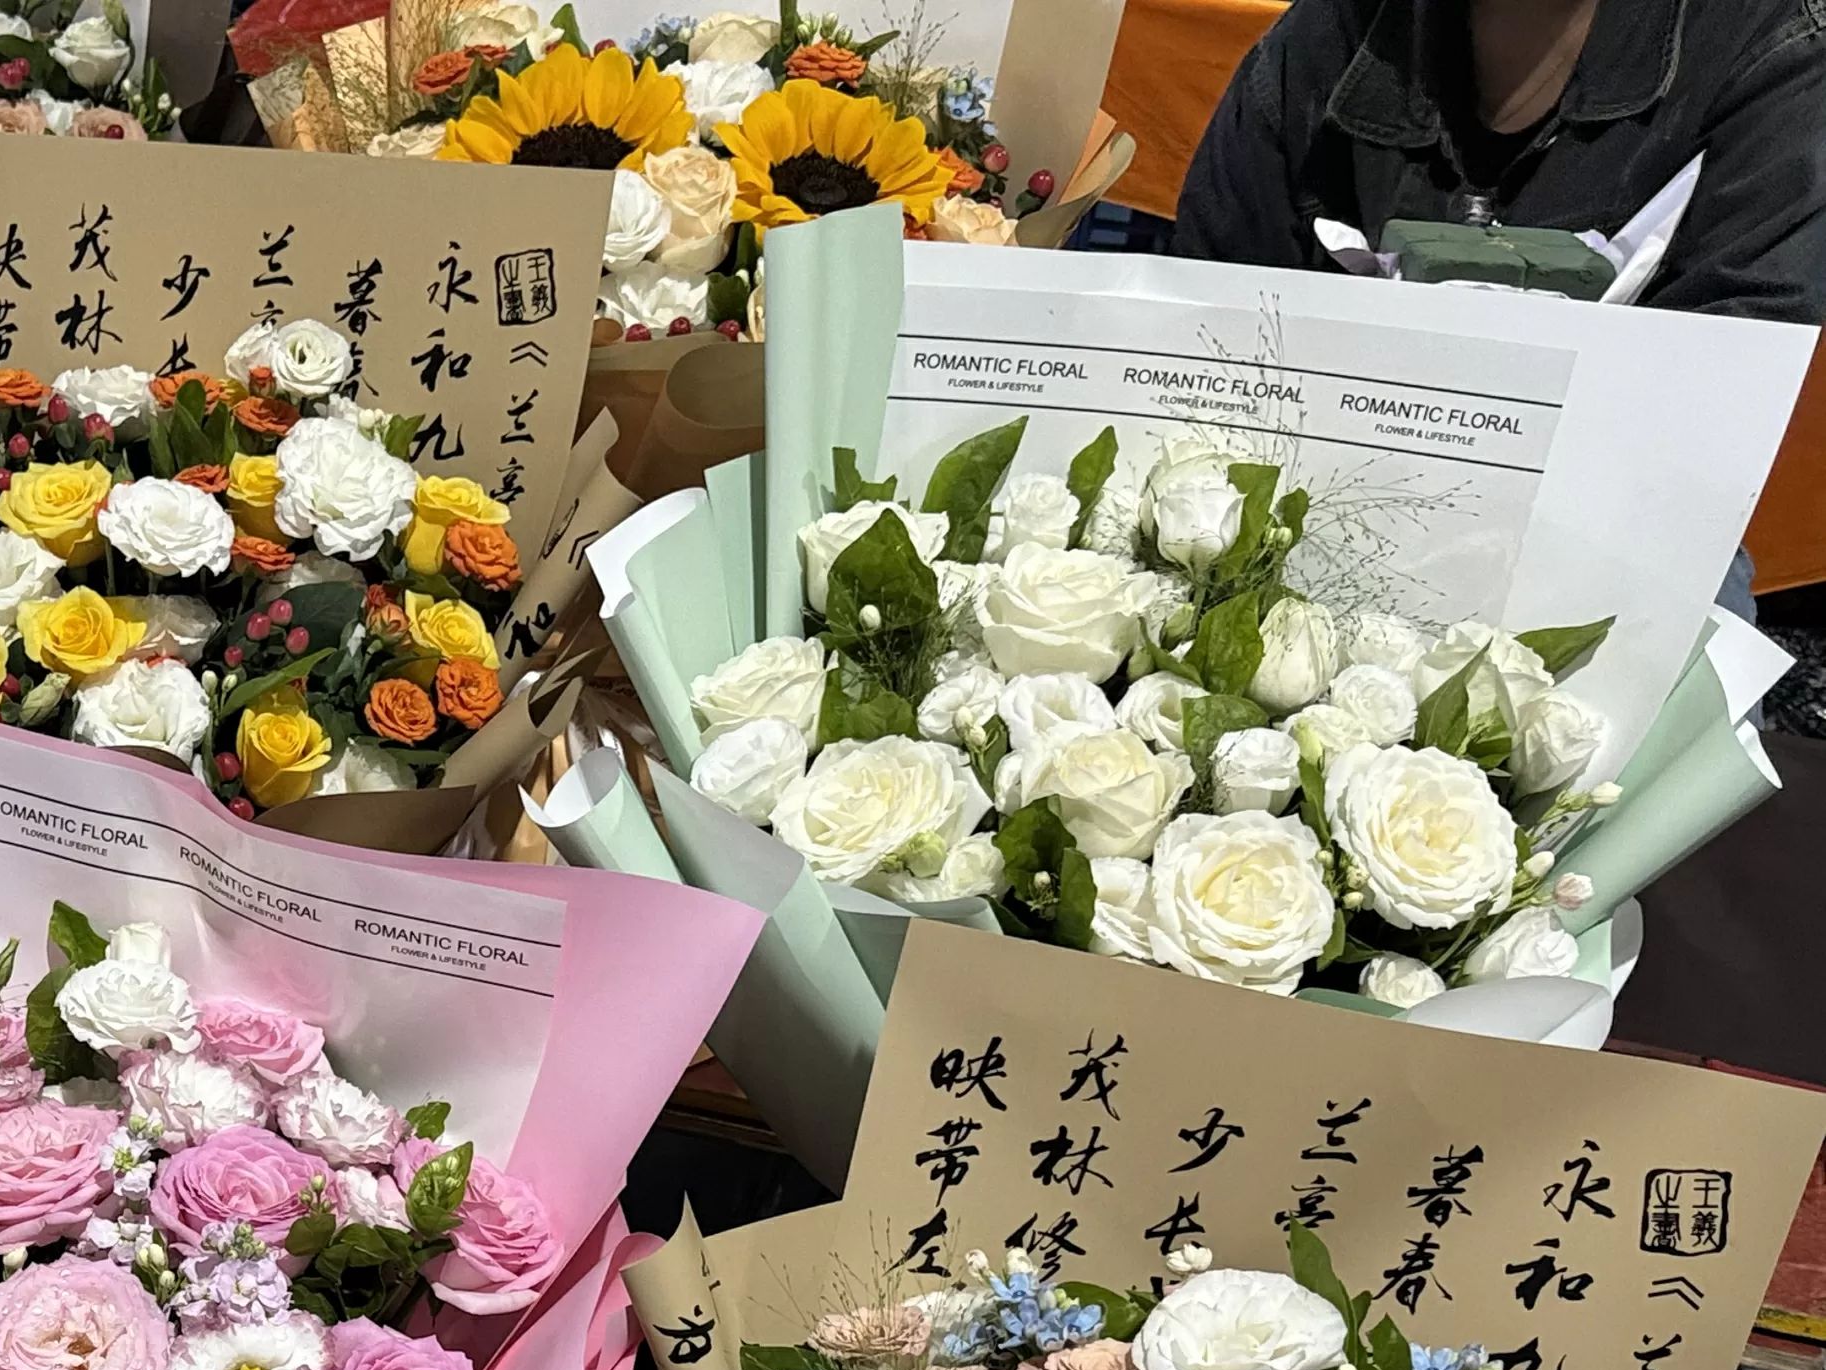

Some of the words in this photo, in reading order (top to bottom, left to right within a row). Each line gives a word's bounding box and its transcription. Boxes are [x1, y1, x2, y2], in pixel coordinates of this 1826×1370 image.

[913, 352, 1012, 374] ROMANTIC
[1016, 359, 1088, 379] FLORAL
[948, 378, 987, 389] FLOWER
[988, 382, 995, 390] &
[996, 381, 1044, 393] LIFESTYLE
[1123, 367, 1226, 394] ROMANTIC
[1231, 379, 1305, 404] FLORAL
[1340, 394, 1443, 423] ROMANTIC
[1448, 409, 1523, 435] FLORAL
[1375, 423, 1415, 438] FLOWER
[1416, 430, 1423, 439] &
[1424, 430, 1476, 447] LIFESTYLE
[21, 826, 56, 843] FLOWER
[57, 836, 63, 845] &
[64, 839, 108, 857] LIFESTYLE
[81, 823, 149, 850] FLORAL
[179, 846, 254, 898] ROMANTIC
[257, 889, 323, 923] FLORAL
[208, 880, 236, 901] FLOWER
[243, 901, 284, 923] LIFESTYLE
[354, 919, 452, 951] ROMANTIC
[457, 938, 530, 967] FLORAL
[391, 945, 429, 960] FLOWER
[438, 956, 487, 971] LIFESTYLE
